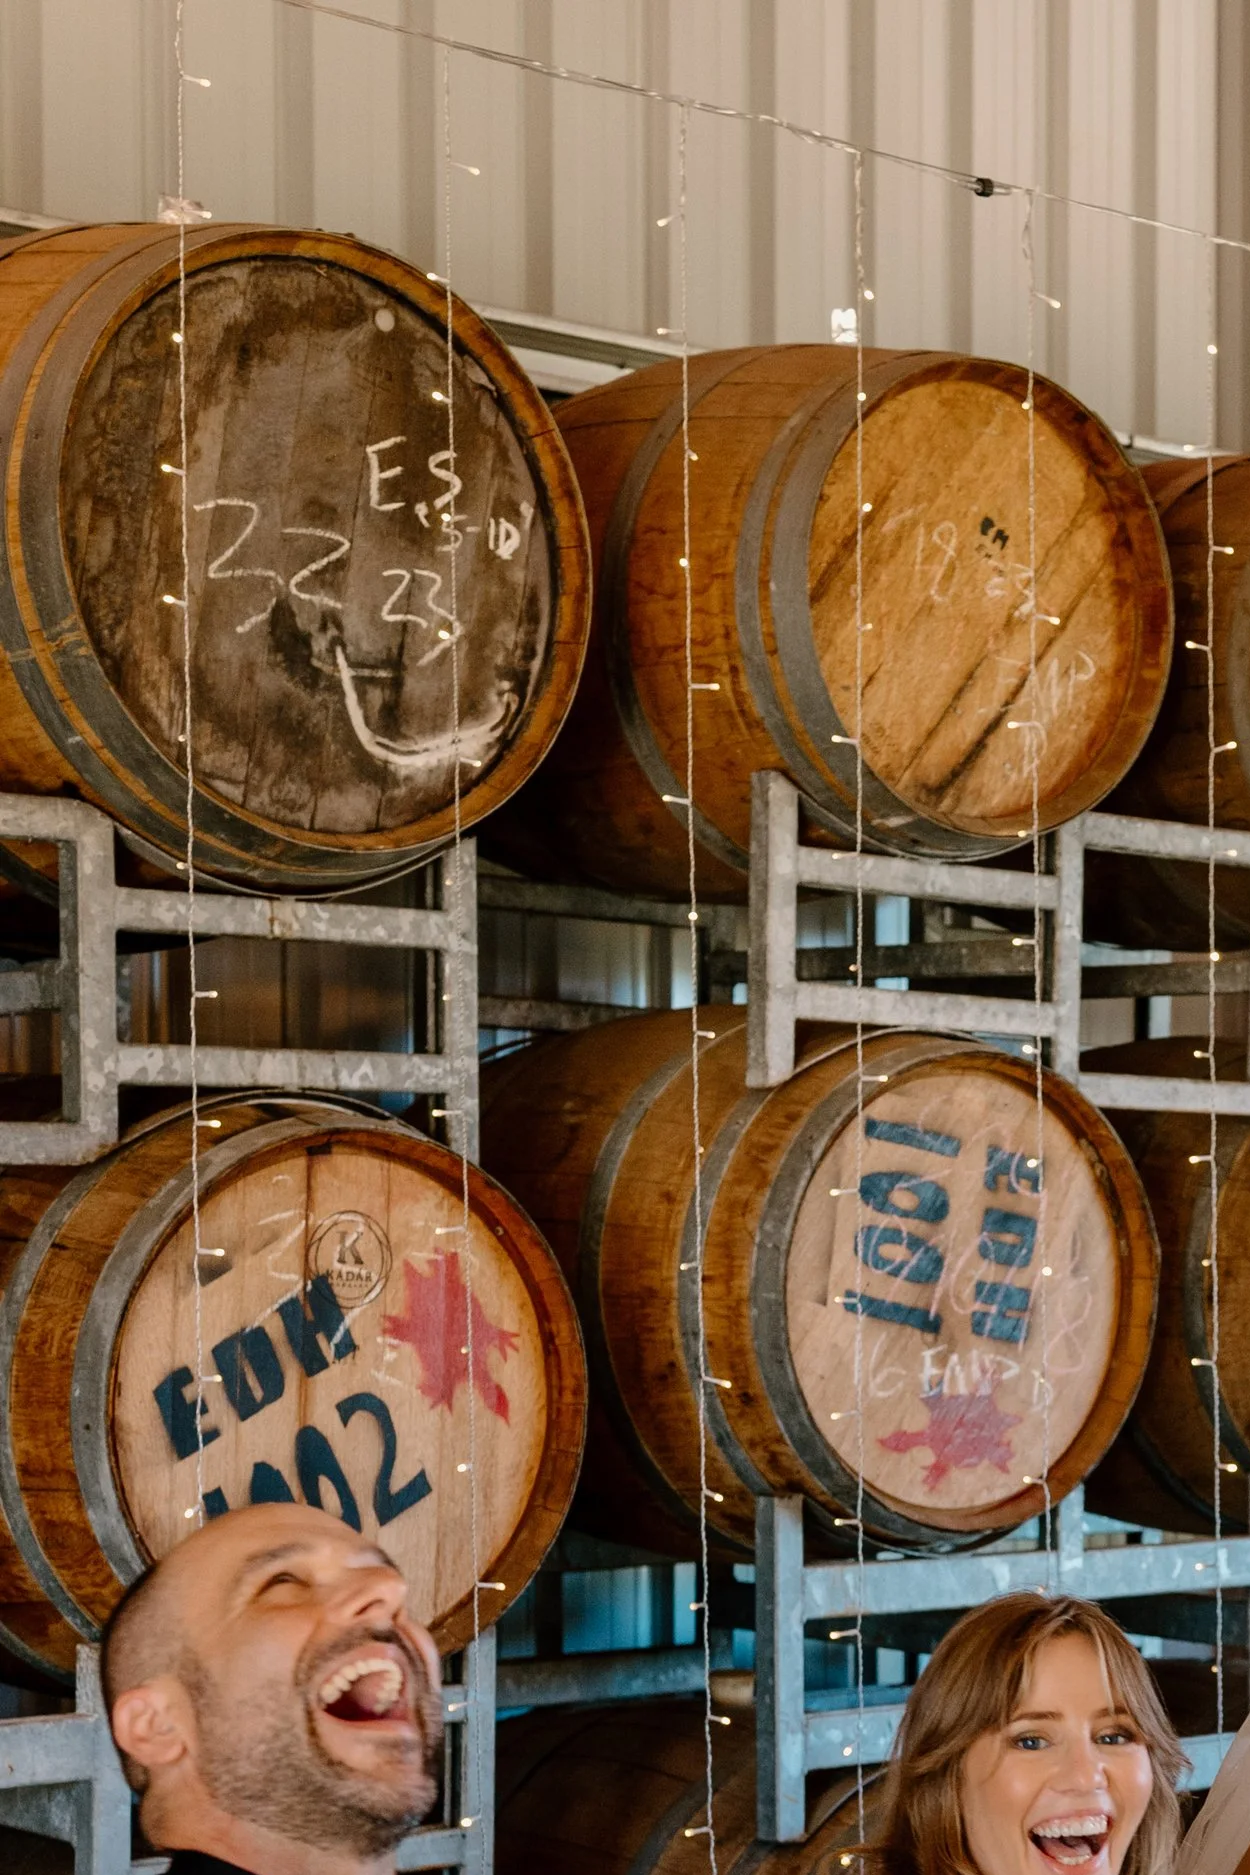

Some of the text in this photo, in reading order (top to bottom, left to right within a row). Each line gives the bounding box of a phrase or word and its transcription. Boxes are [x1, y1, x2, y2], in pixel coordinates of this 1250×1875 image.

[843, 1118, 962, 1334] 1001
[971, 1143, 1044, 1344] EDH
[153, 1276, 356, 1460] EDH
